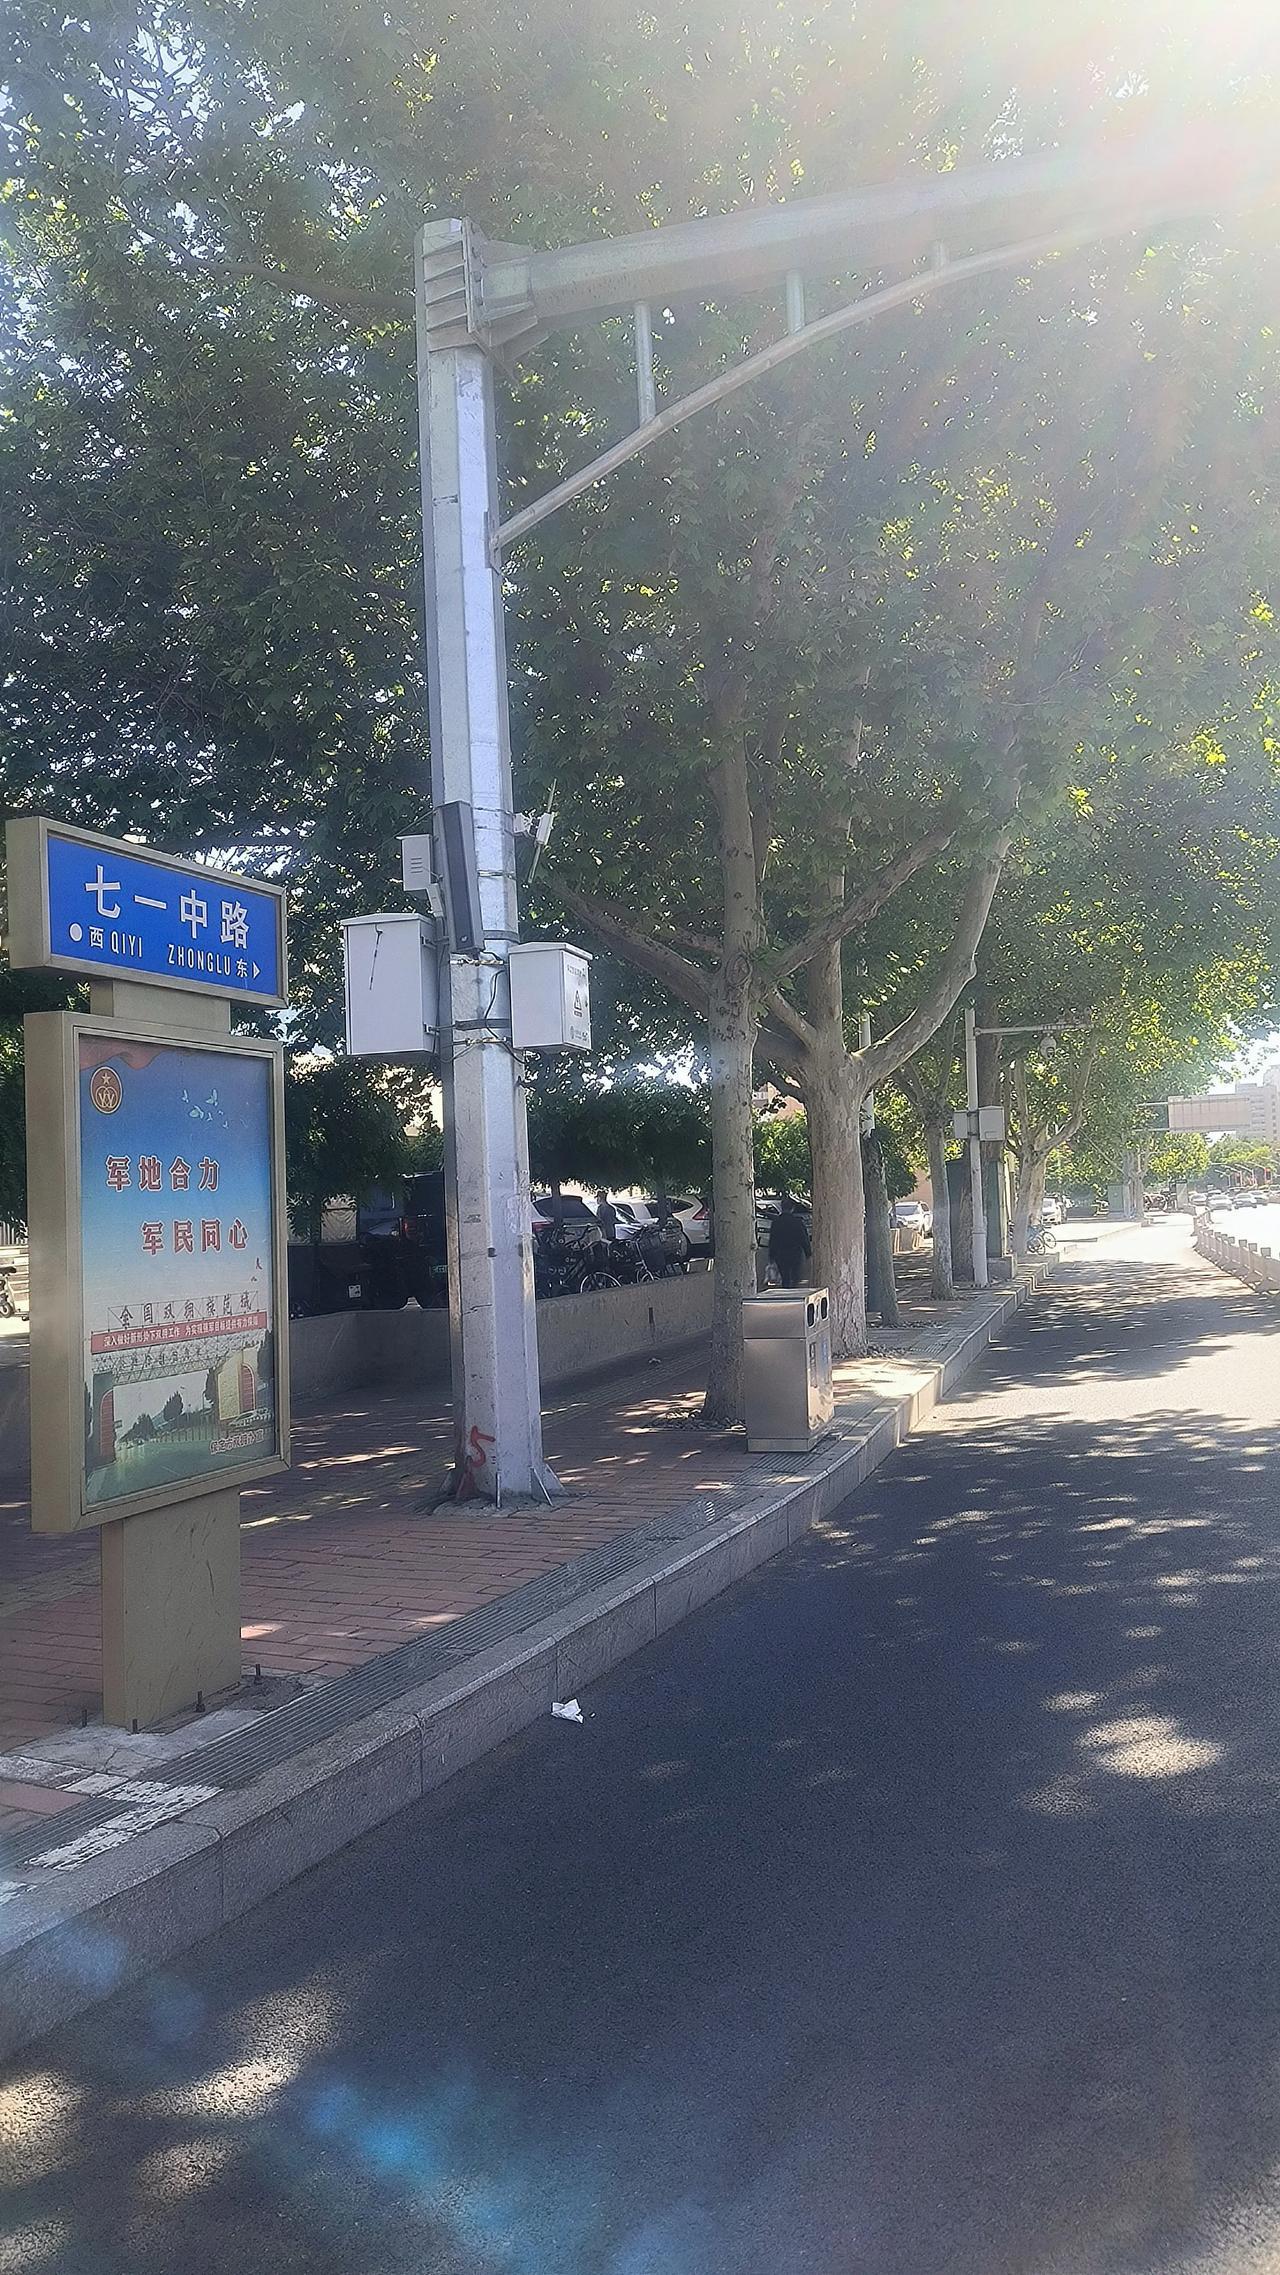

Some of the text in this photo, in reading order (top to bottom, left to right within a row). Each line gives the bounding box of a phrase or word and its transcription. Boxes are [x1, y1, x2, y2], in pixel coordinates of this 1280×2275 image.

[85, 864, 249, 950] 七一中路
[88, 926, 248, 978] 西 QIYI ZHONGLU 东
[106, 1154, 220, 1192] 军地合力
[140, 1216, 249, 1255] 军民同心
